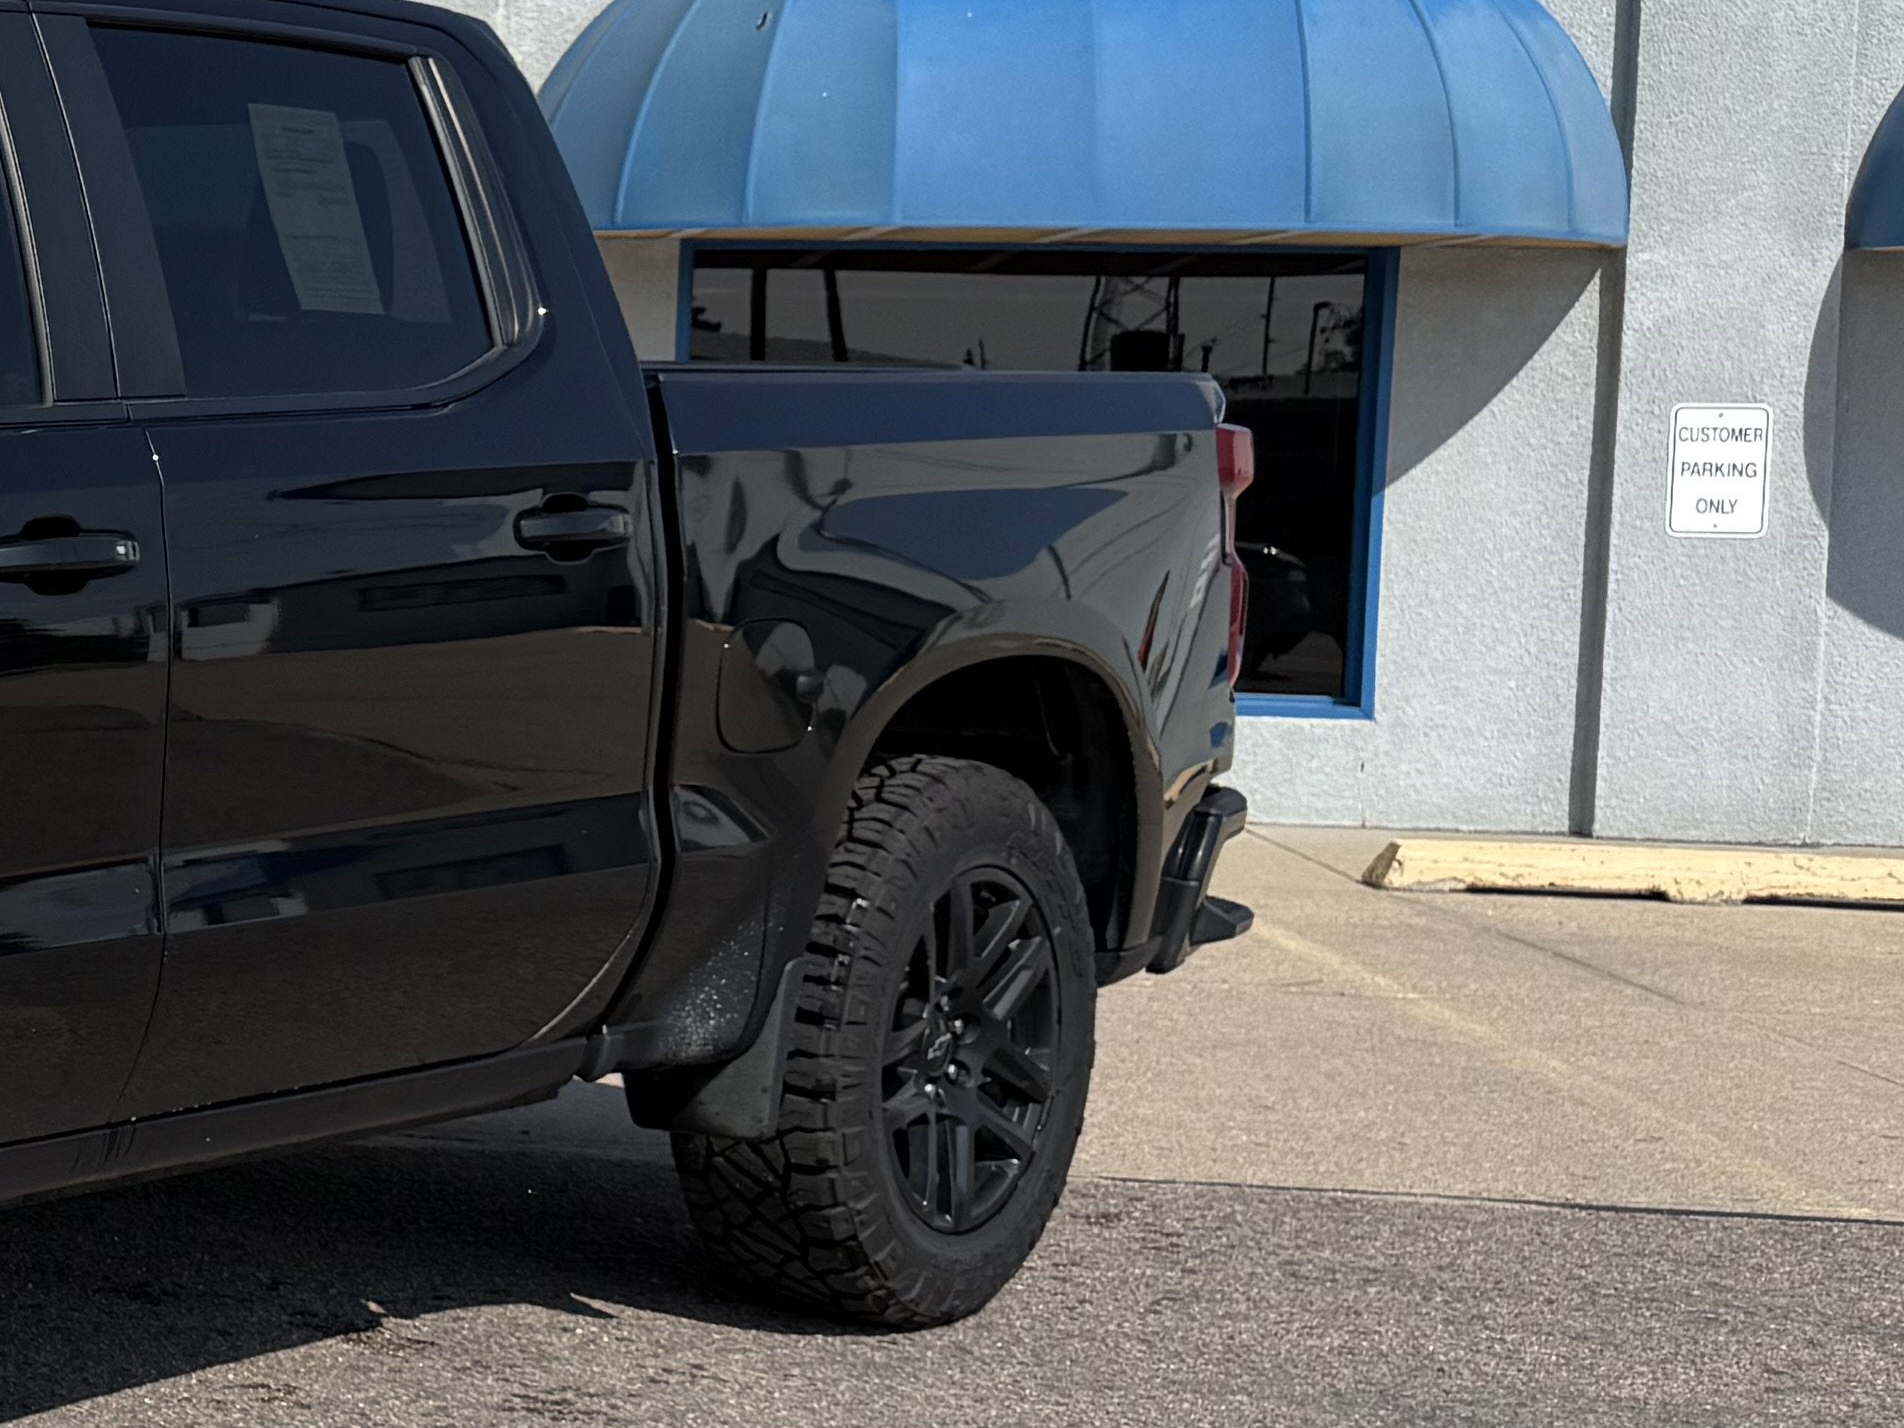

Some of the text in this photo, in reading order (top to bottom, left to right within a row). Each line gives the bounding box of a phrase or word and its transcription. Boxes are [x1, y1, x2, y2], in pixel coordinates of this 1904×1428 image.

[1678, 426, 1763, 443] CUSTOMER
[1680, 462, 1757, 478] PARKING
[1695, 498, 1738, 515] ONLY
